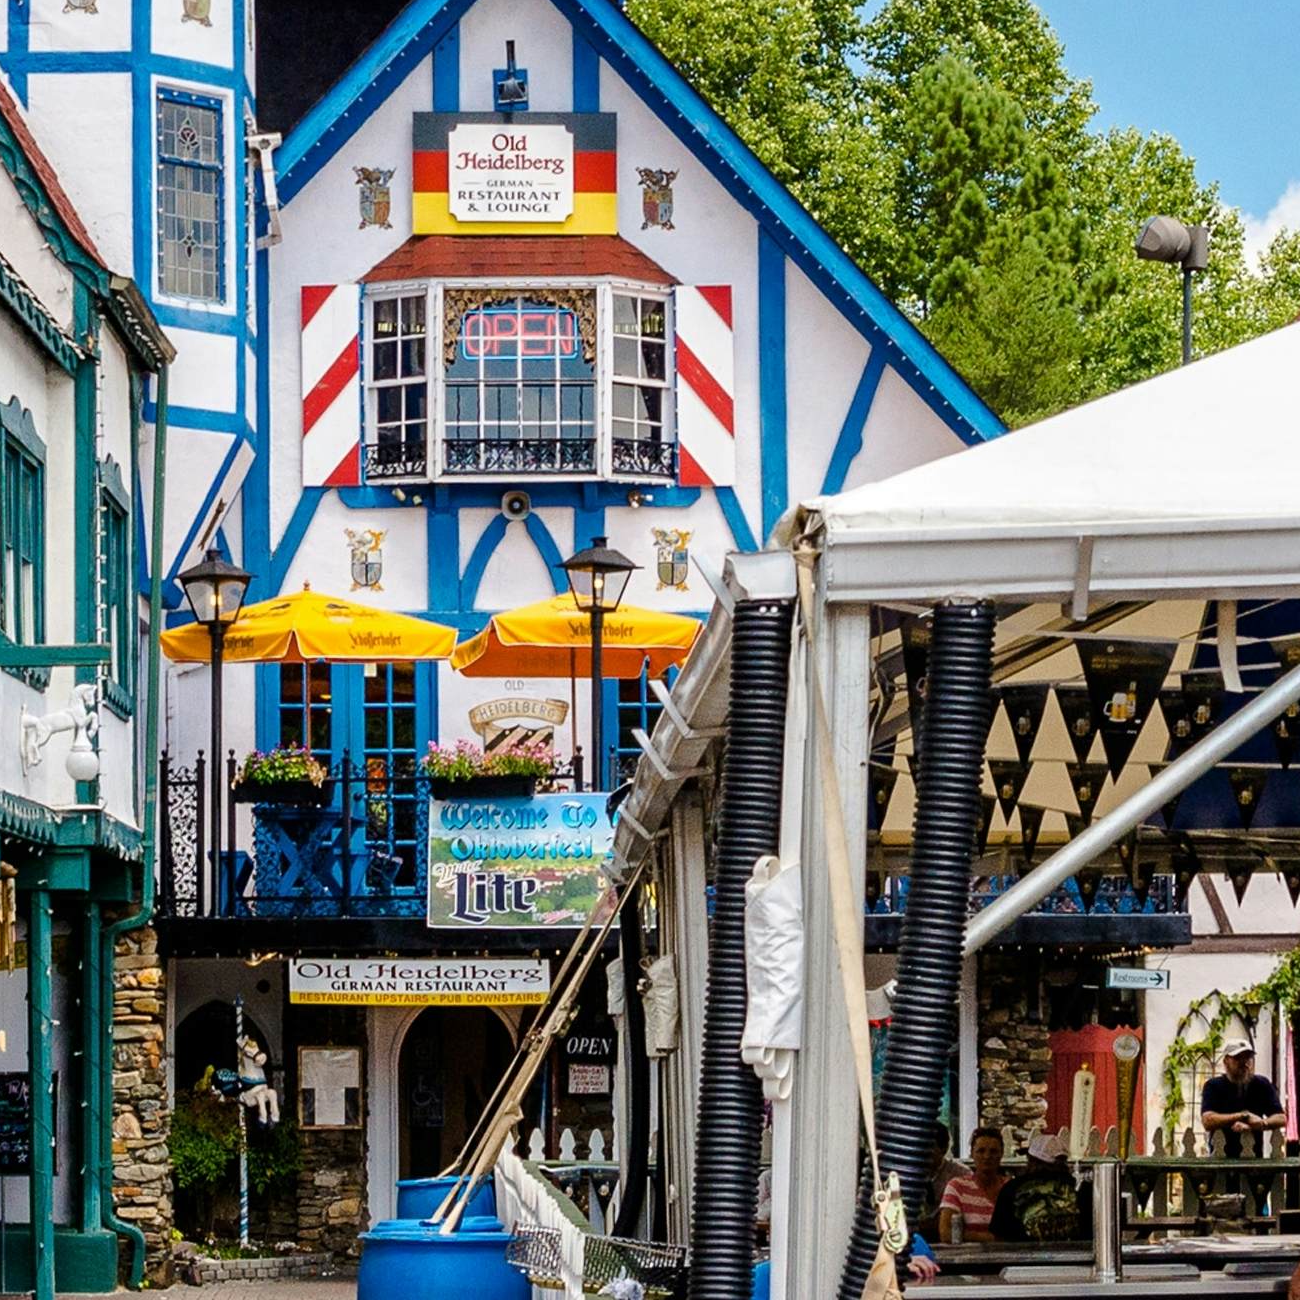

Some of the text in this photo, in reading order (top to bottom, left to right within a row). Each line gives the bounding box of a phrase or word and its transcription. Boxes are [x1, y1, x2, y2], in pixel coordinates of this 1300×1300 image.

[491, 133, 527, 152] Old
[455, 152, 565, 175] Heidelberg
[486, 179, 533, 188] GERMAN
[457, 190, 562, 201] RESTAURANT
[467, 202, 550, 213] & LOUNGE
[465, 314, 573, 355] OPEN
[504, 680, 525, 691] OLD
[479, 701, 556, 720] HEIDELBERG
[440, 803, 549, 831] Welcome
[561, 801, 598, 830] To
[450, 833, 594, 861] Oktoberfest
[450, 872, 540, 925] Lite
[296, 962, 543, 984] Old Heidelberg
[331, 980, 508, 991] GERMAN RESTAURANT
[299, 993, 542, 1003] RESTAURANT UPSTAIRS PUB DOWNSTAIRS
[566, 1037, 612, 1055] OPEN
